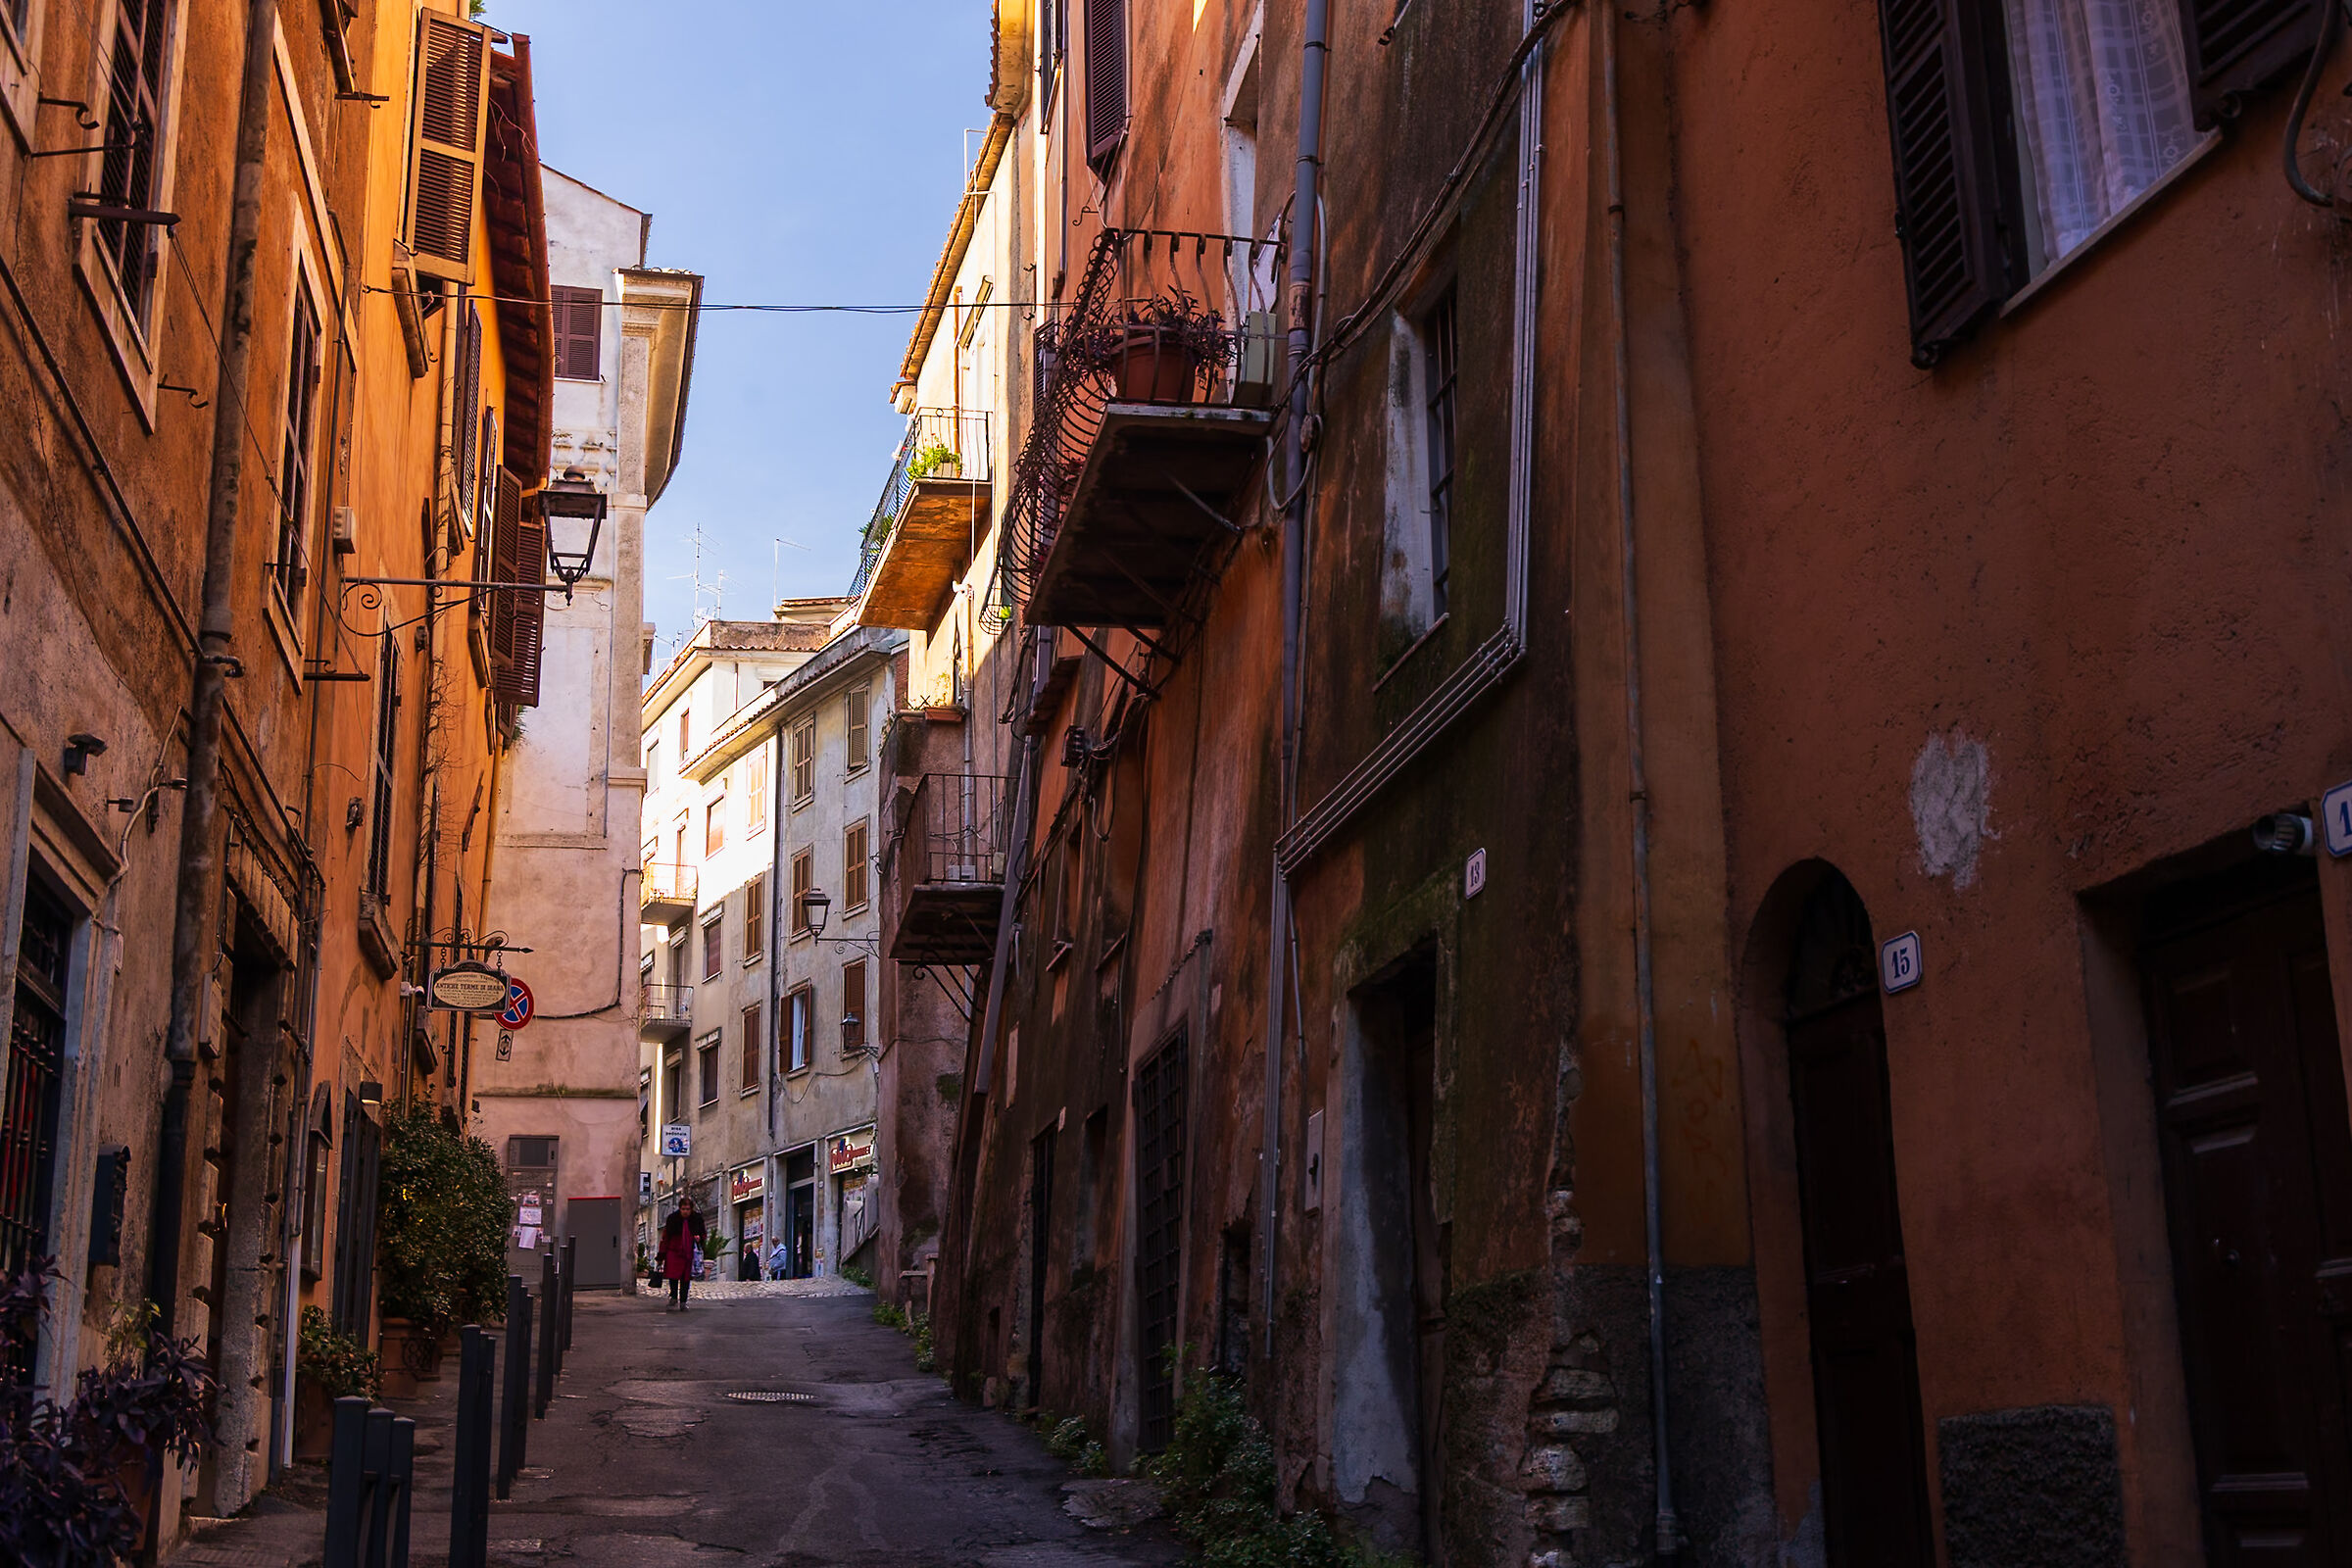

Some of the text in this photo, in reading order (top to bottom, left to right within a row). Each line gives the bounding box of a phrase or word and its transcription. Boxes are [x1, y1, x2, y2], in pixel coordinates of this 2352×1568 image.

[2340, 800, 2352, 838] 1
[1470, 860, 1481, 888] 13
[1891, 947, 1910, 979] 15
